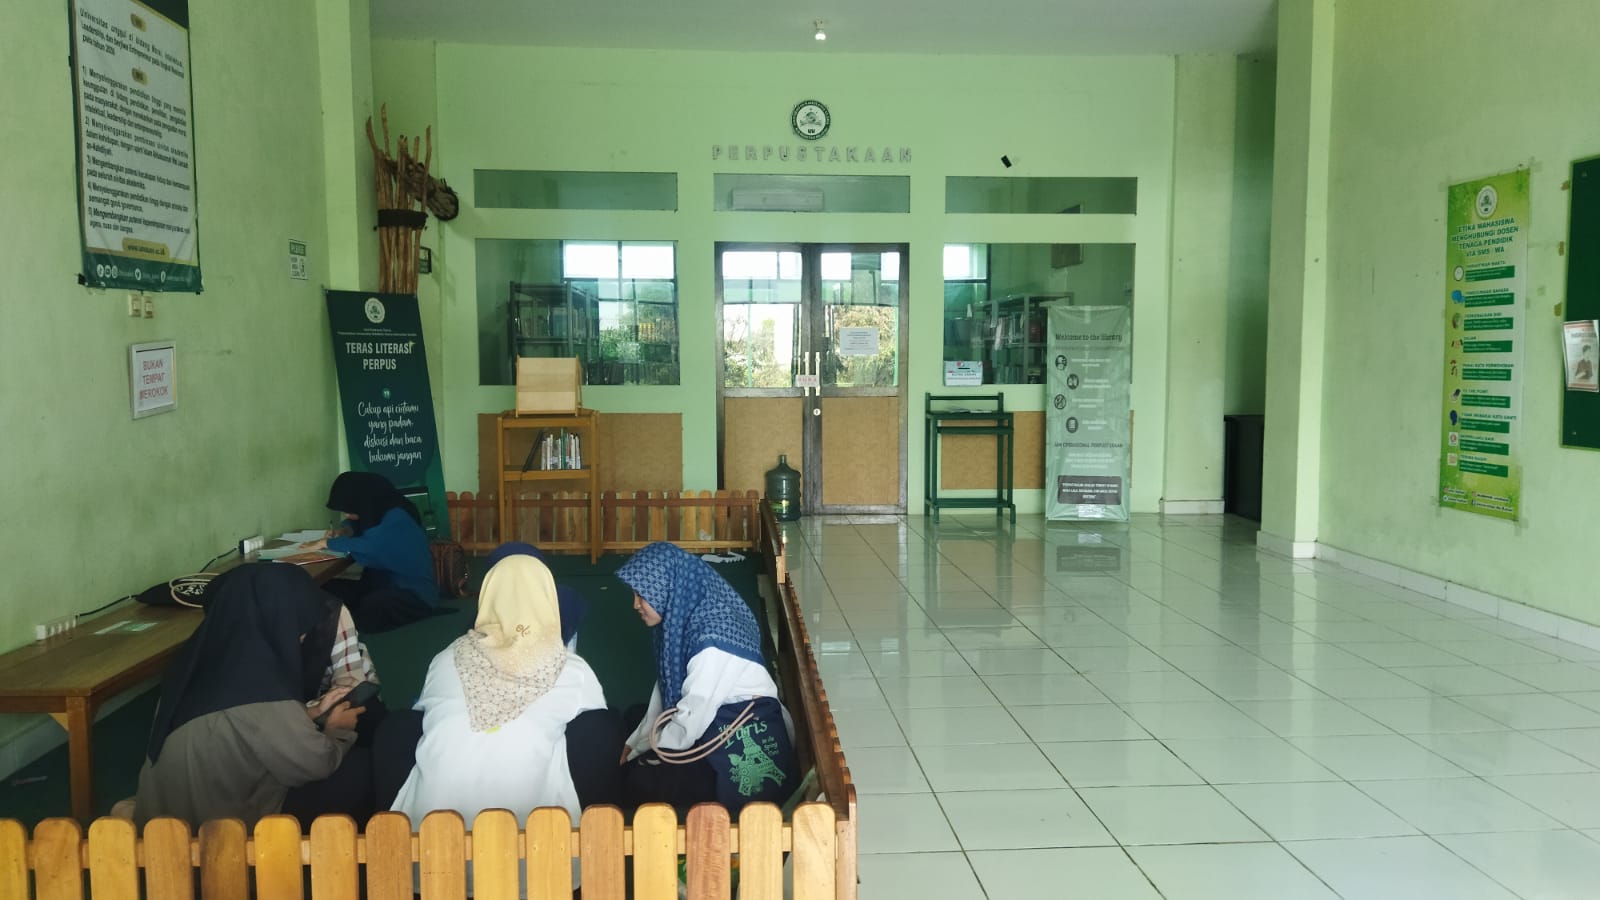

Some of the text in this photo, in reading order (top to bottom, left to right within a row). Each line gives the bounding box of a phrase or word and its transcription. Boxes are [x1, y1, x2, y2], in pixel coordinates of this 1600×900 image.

[712, 144, 912, 164] PERPUSTAKAAN
[1477, 218, 1515, 229] MAHASISWA
[1459, 240, 1482, 249] TENAGA
[346, 342, 412, 354] TERAS LITERASI
[143, 360, 164, 371] BUKAN
[363, 358, 397, 370] PERPUS
[142, 372, 166, 385] TEMPAT
[358, 402, 381, 418] Cukup
[382, 404, 394, 418] api
[368, 420, 387, 434] yang
[364, 434, 388, 448] diskusi
[390, 434, 404, 447] dan
[369, 449, 421, 467] bukumu jangan
